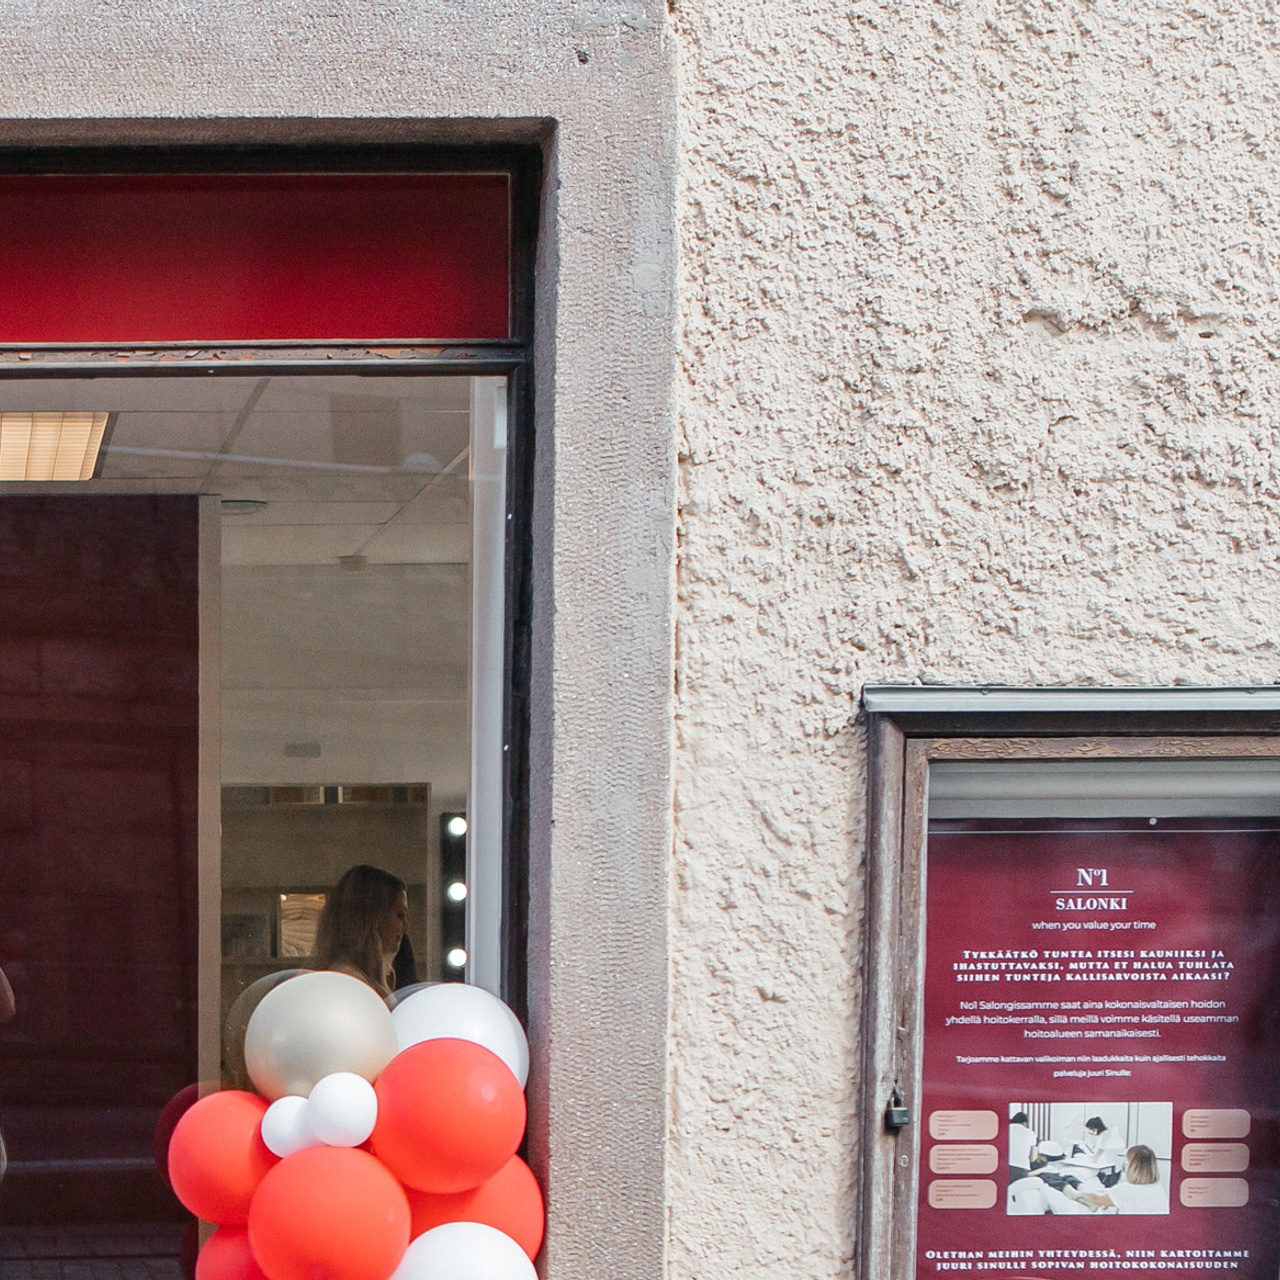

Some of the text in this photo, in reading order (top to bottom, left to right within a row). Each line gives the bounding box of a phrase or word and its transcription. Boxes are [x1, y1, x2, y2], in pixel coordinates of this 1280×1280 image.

[1055, 897, 1127, 911] SALONKI
[1031, 920, 1157, 932] when you value your time
[1043, 950, 1093, 959] TUNTEA
[1097, 950, 1135, 959] ITSESI
[1139, 949, 1206, 958] KAUNIIKSI
[1211, 949, 1225, 959] JA
[953, 961, 1234, 971] IHASTUTTAVAKSI, MUTTA ET HALUA TUHLATA
[956, 971, 1230, 983] SIIHEN TUNTEJA KALLISARVOISTA AIKAASI?
[978, 1000, 1060, 1012] Salongissamme
[1060, 1001, 1082, 1010] saat
[1082, 1001, 1104, 1010] aina
[1104, 999, 1189, 1009] kokonaisvaltaisen
[1190, 999, 1226, 1009] hoidon
[944, 1014, 1239, 1027] yhdellä hoitokerralla, sillä meillä voimme käsitellä useamman
[1023, 1028, 1161, 1039] hoitoalueen samanaikaisesti.
[925, 1248, 1249, 1259] OLETHAN MEIHIN YHTEYDESSÄ, NIIN KARTOITAMME
[936, 1260, 1238, 1272] JUURI SINULLE SOPIVAN HOITOKOKONAISUUDEN
